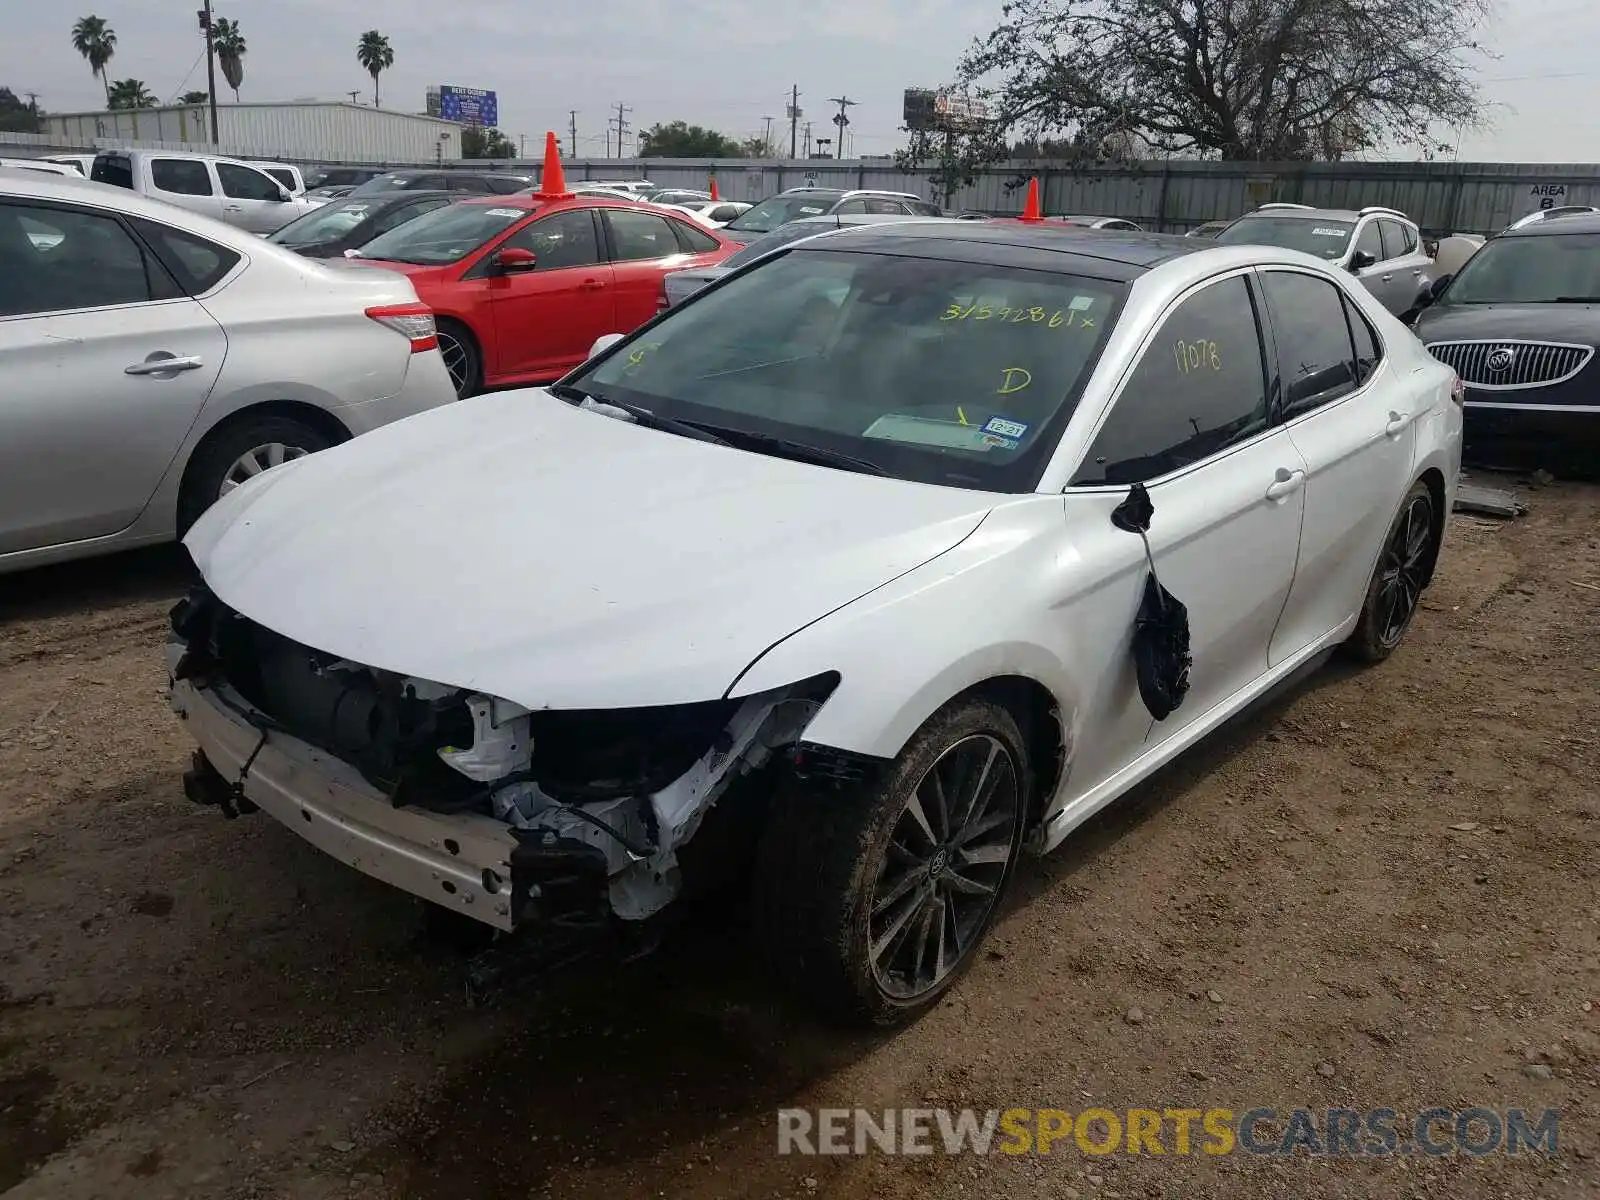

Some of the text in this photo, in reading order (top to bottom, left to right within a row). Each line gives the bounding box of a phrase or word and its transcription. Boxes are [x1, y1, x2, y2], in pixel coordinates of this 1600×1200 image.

[1531, 185, 1565, 195] AREA
[1540, 198, 1554, 209] B
[997, 367, 1032, 393] D
